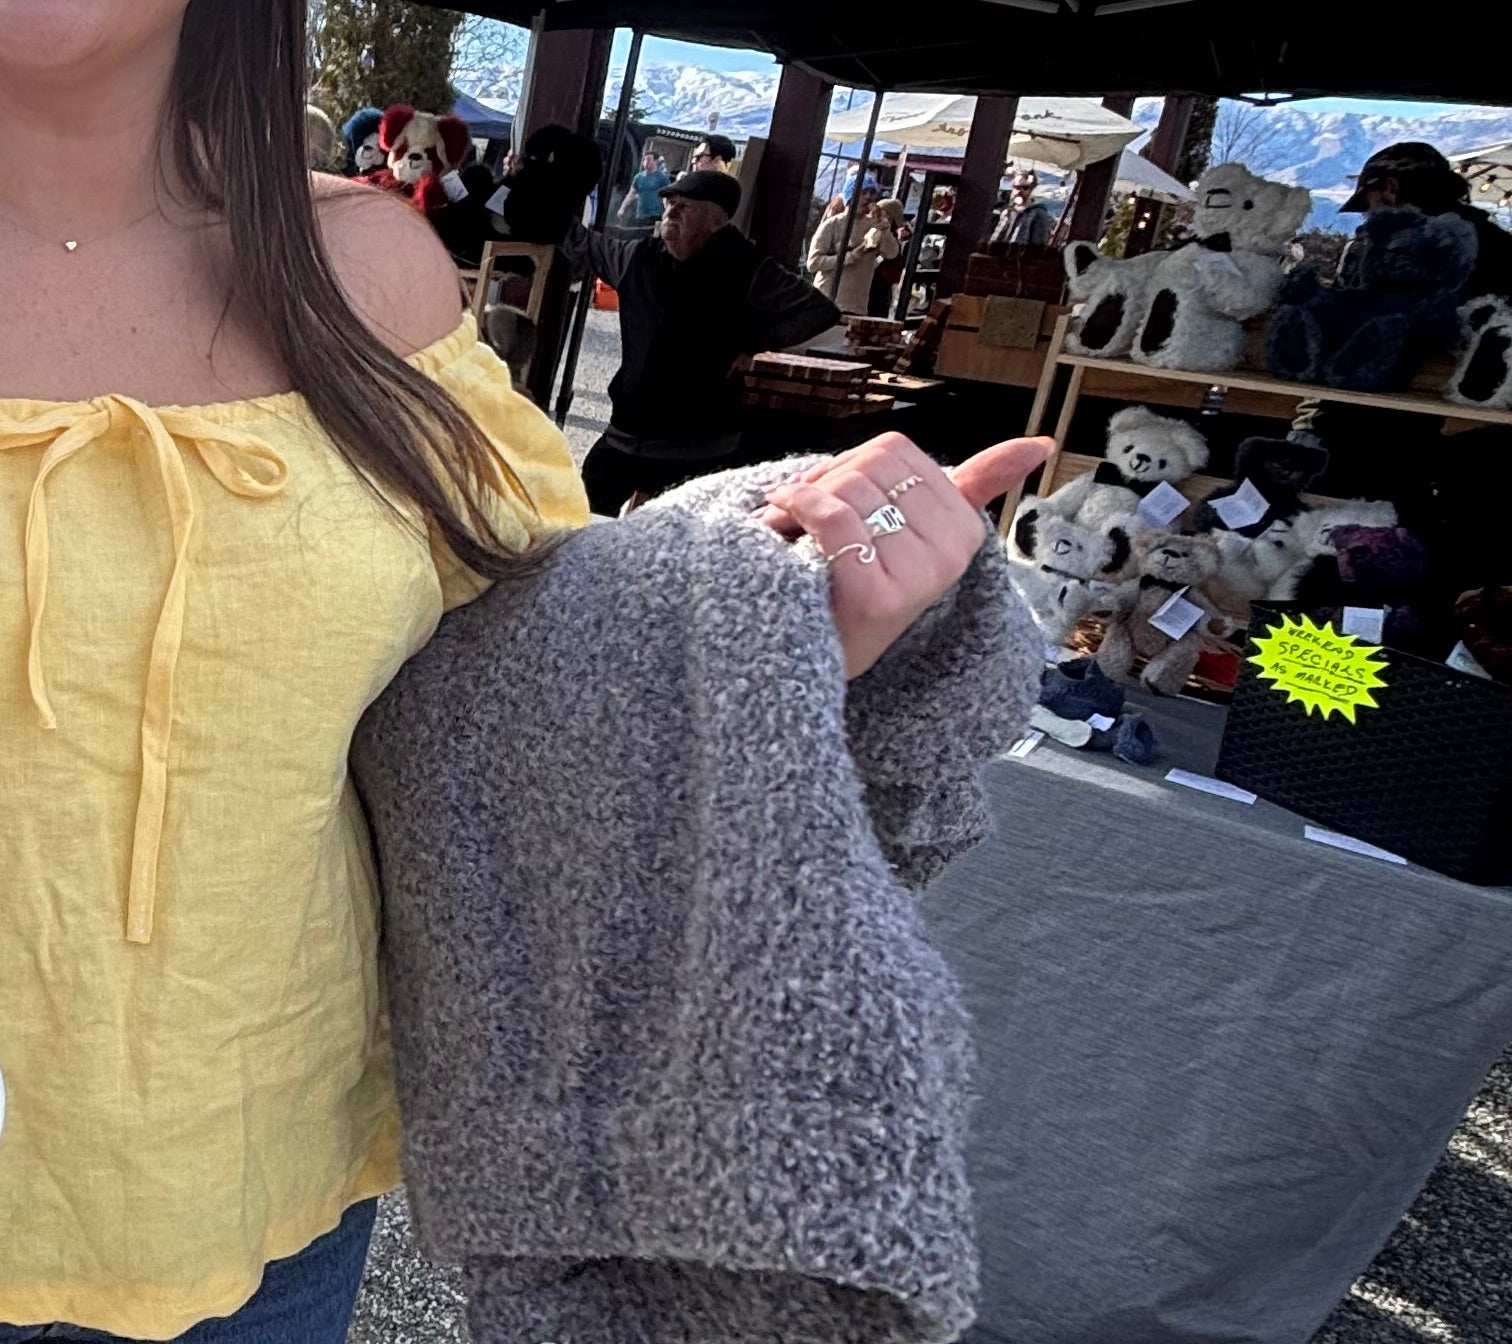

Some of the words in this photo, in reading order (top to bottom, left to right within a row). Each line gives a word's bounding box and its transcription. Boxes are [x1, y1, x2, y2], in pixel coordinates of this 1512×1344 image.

[1278, 641, 1366, 679] SPECIALS
[1270, 662, 1287, 674] AS
[1294, 672, 1358, 697] MARKED
